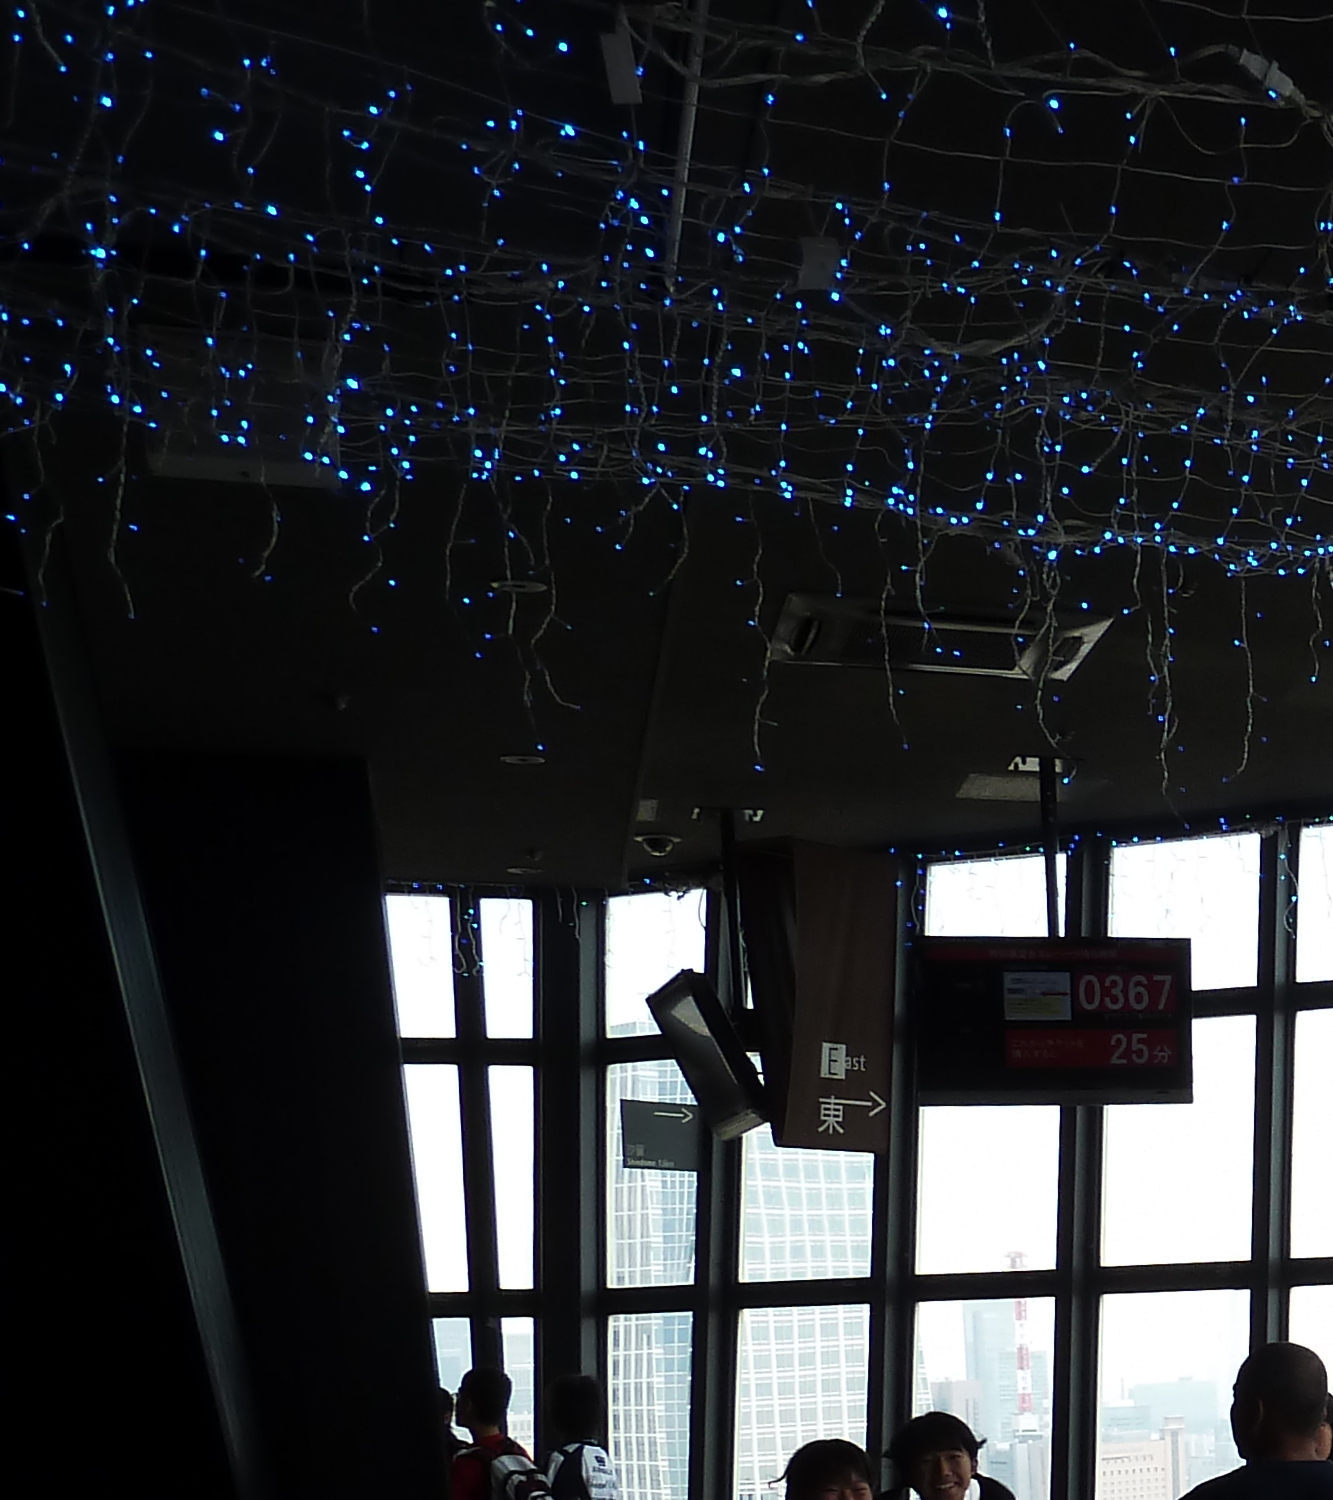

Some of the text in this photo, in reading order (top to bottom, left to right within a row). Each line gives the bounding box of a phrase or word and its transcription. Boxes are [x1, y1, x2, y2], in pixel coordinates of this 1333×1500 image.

[1078, 974, 1173, 1011] 0367
[826, 1046, 867, 1076] East
[817, 1094, 845, 1135] 東
